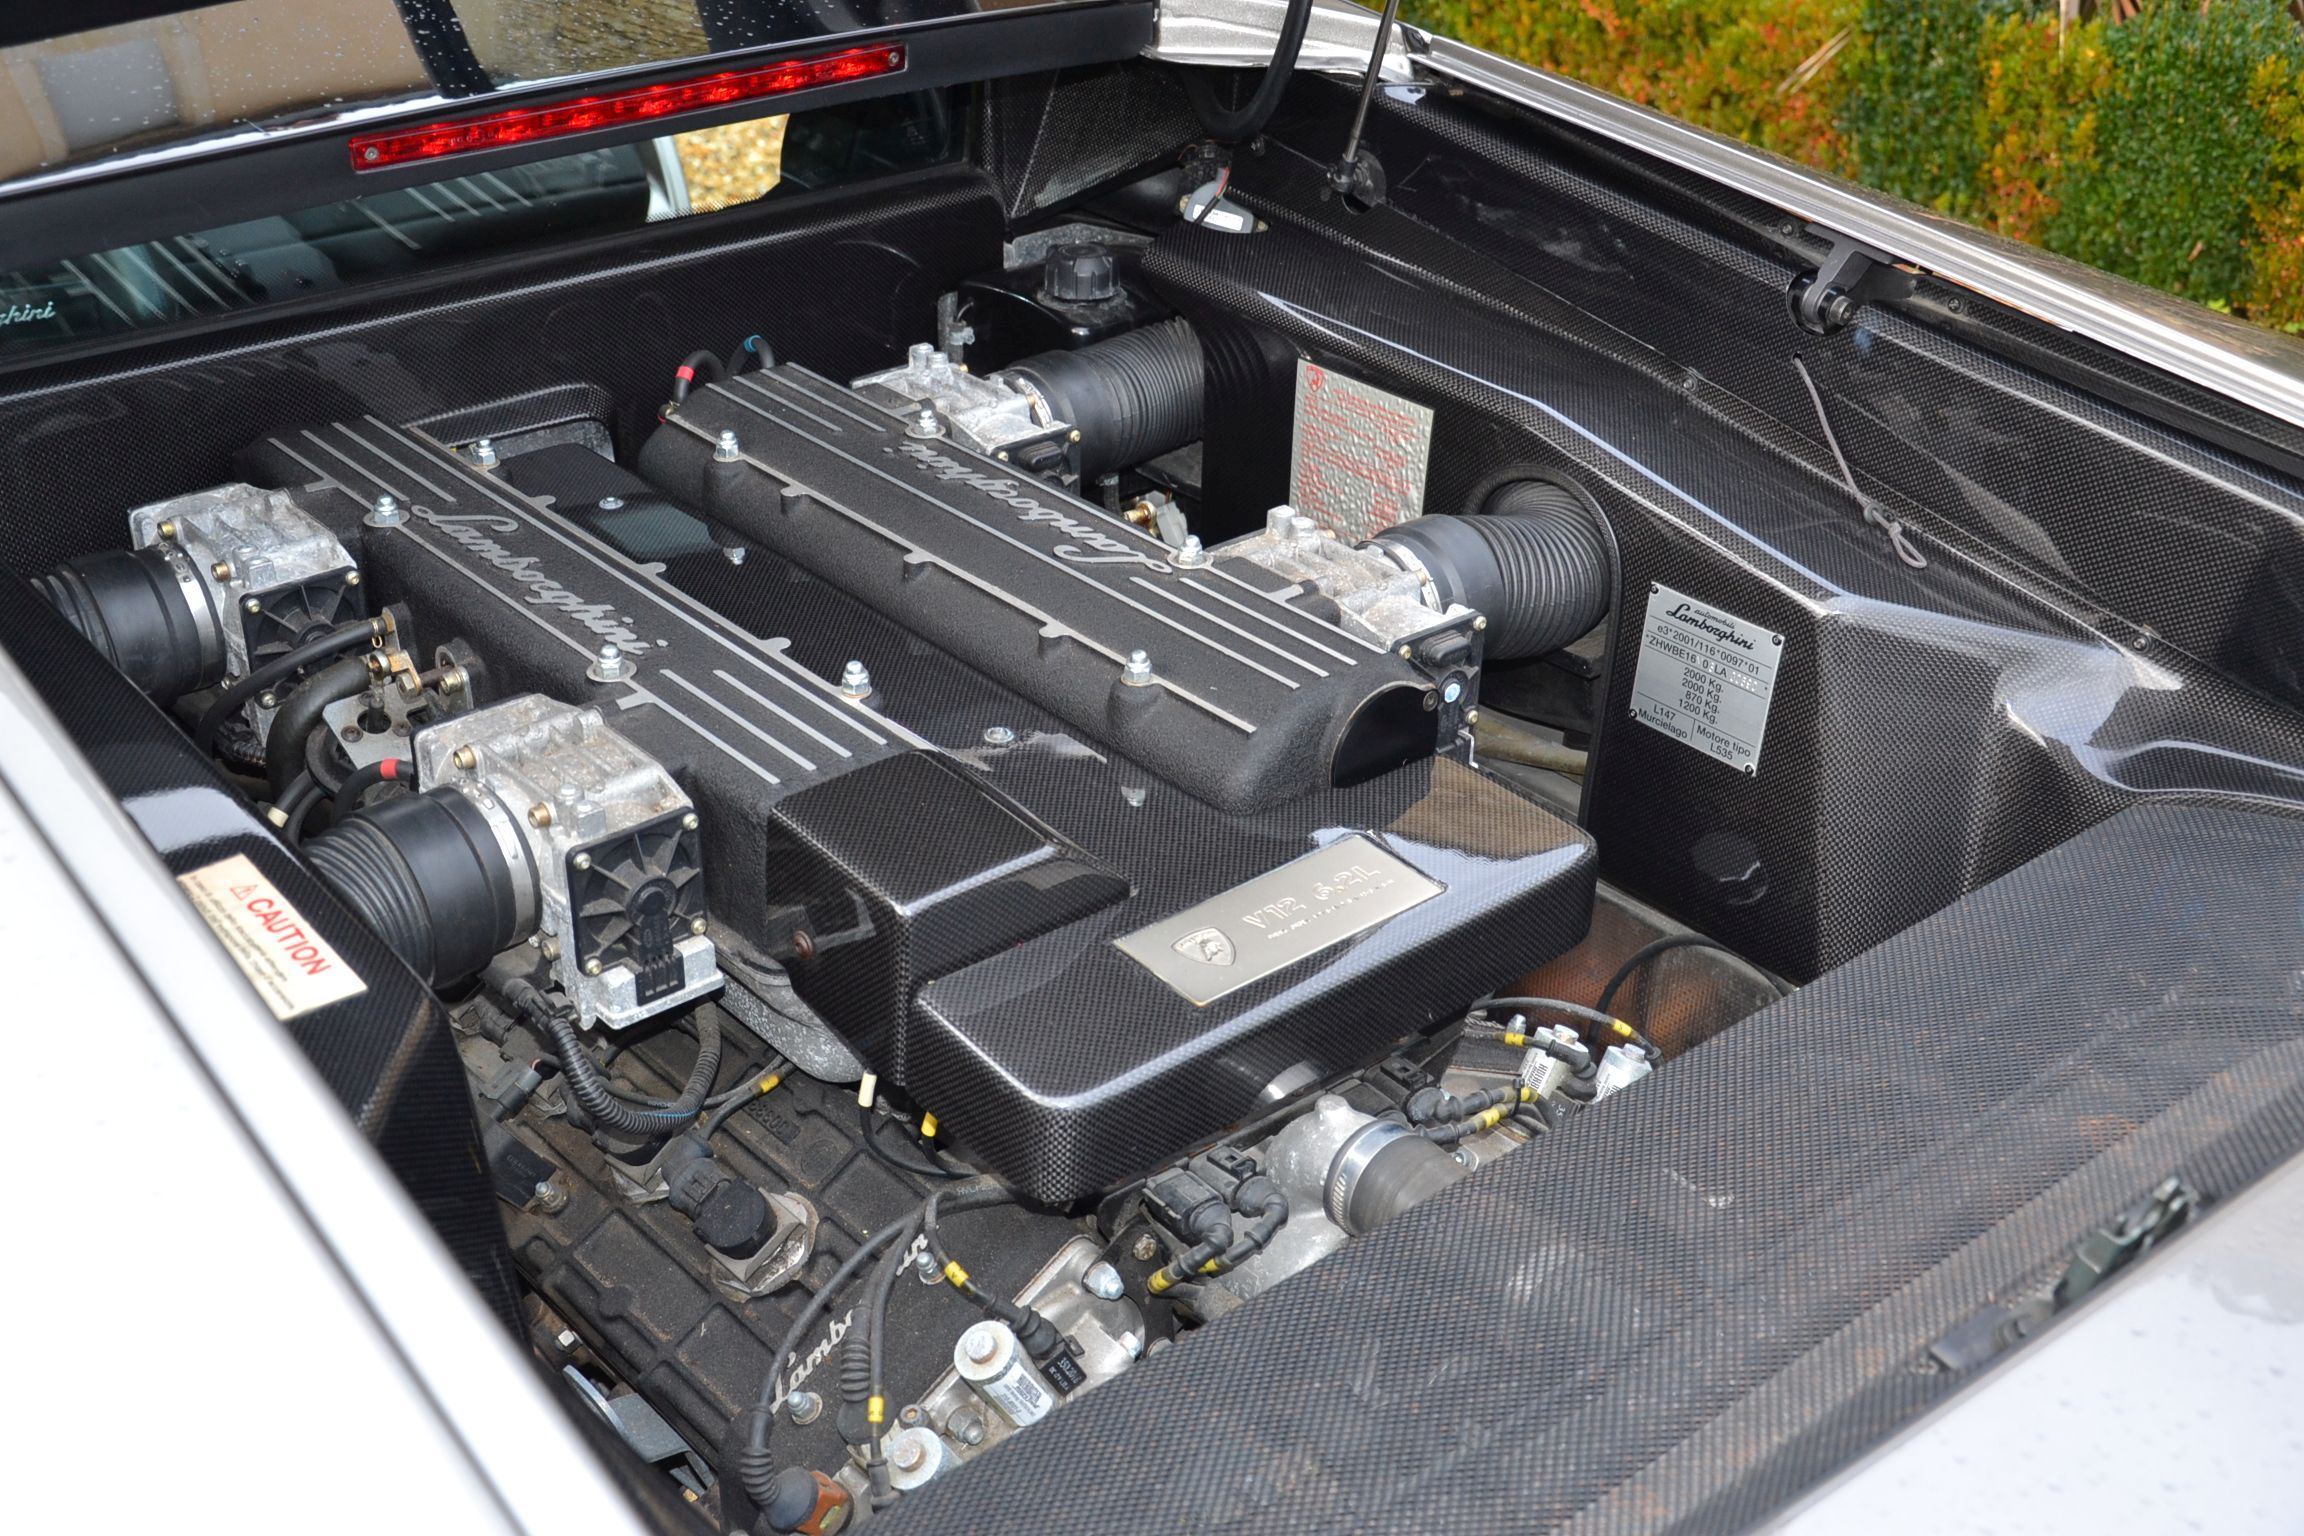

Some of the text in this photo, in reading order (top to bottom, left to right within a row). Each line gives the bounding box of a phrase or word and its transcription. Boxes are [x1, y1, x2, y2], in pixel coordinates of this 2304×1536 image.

[898, 441, 1173, 574] Lamborghini
[411, 504, 669, 656] Lamborghini
[1665, 603, 1756, 650] Lamborghini
[1682, 678, 1722, 703] 2000 Kg.
[1684, 667, 1725, 693] 2000 Kg.
[1653, 704, 1676, 721] L147
[1679, 699, 1718, 725] 1200 Kg.
[1685, 691, 1720, 714] 870 Kg.
[1638, 707, 1688, 740] Murcielago
[1696, 725, 1751, 758] Motore tipo
[1710, 742, 1733, 760] L535
[1242, 896, 1307, 929] V12
[246, 898, 332, 976] CAUTION
